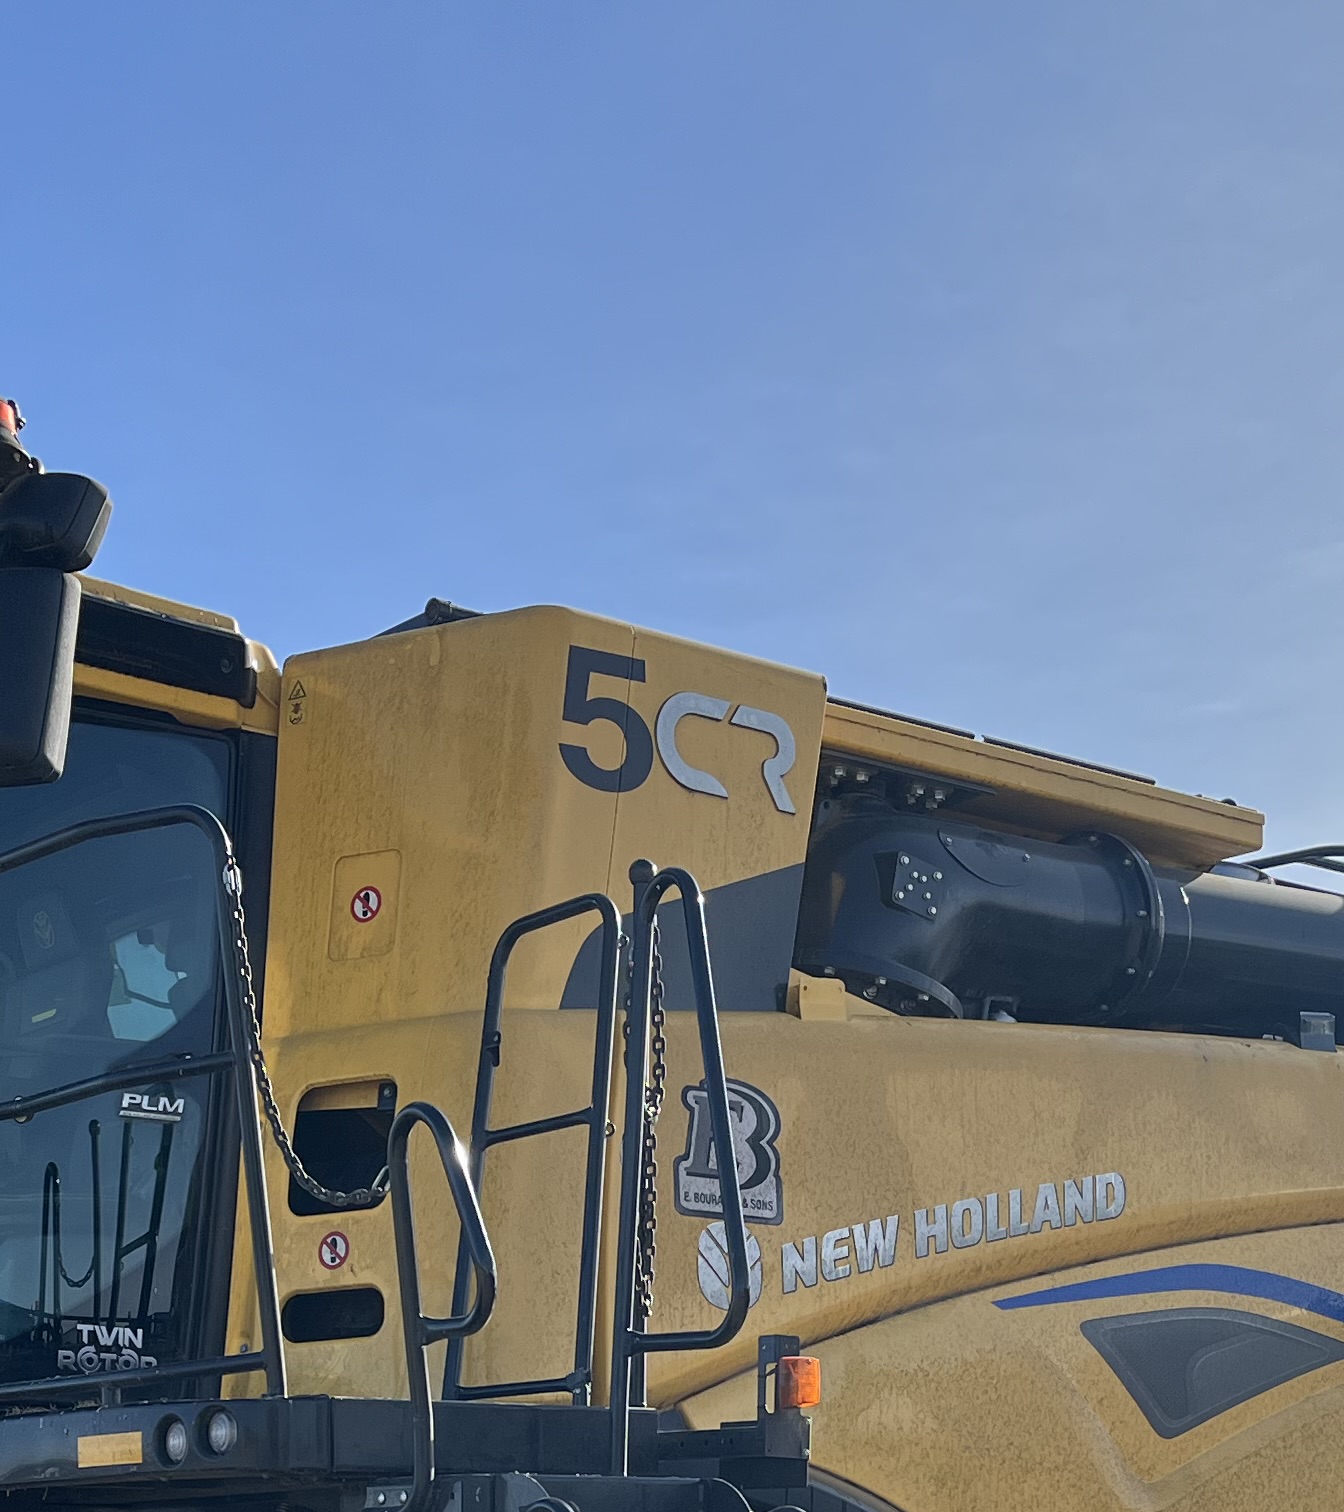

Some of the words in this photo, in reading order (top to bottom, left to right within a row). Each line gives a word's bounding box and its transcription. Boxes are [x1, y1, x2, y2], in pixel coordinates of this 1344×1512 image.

[121, 1092, 185, 1114] PLM
[750, 1198, 774, 1211] SONS
[782, 1214, 899, 1294] NEW
[914, 1172, 1127, 1258] HOLLAND
[77, 1323, 143, 1349] TWIN
[57, 1344, 157, 1376] ROTOR
